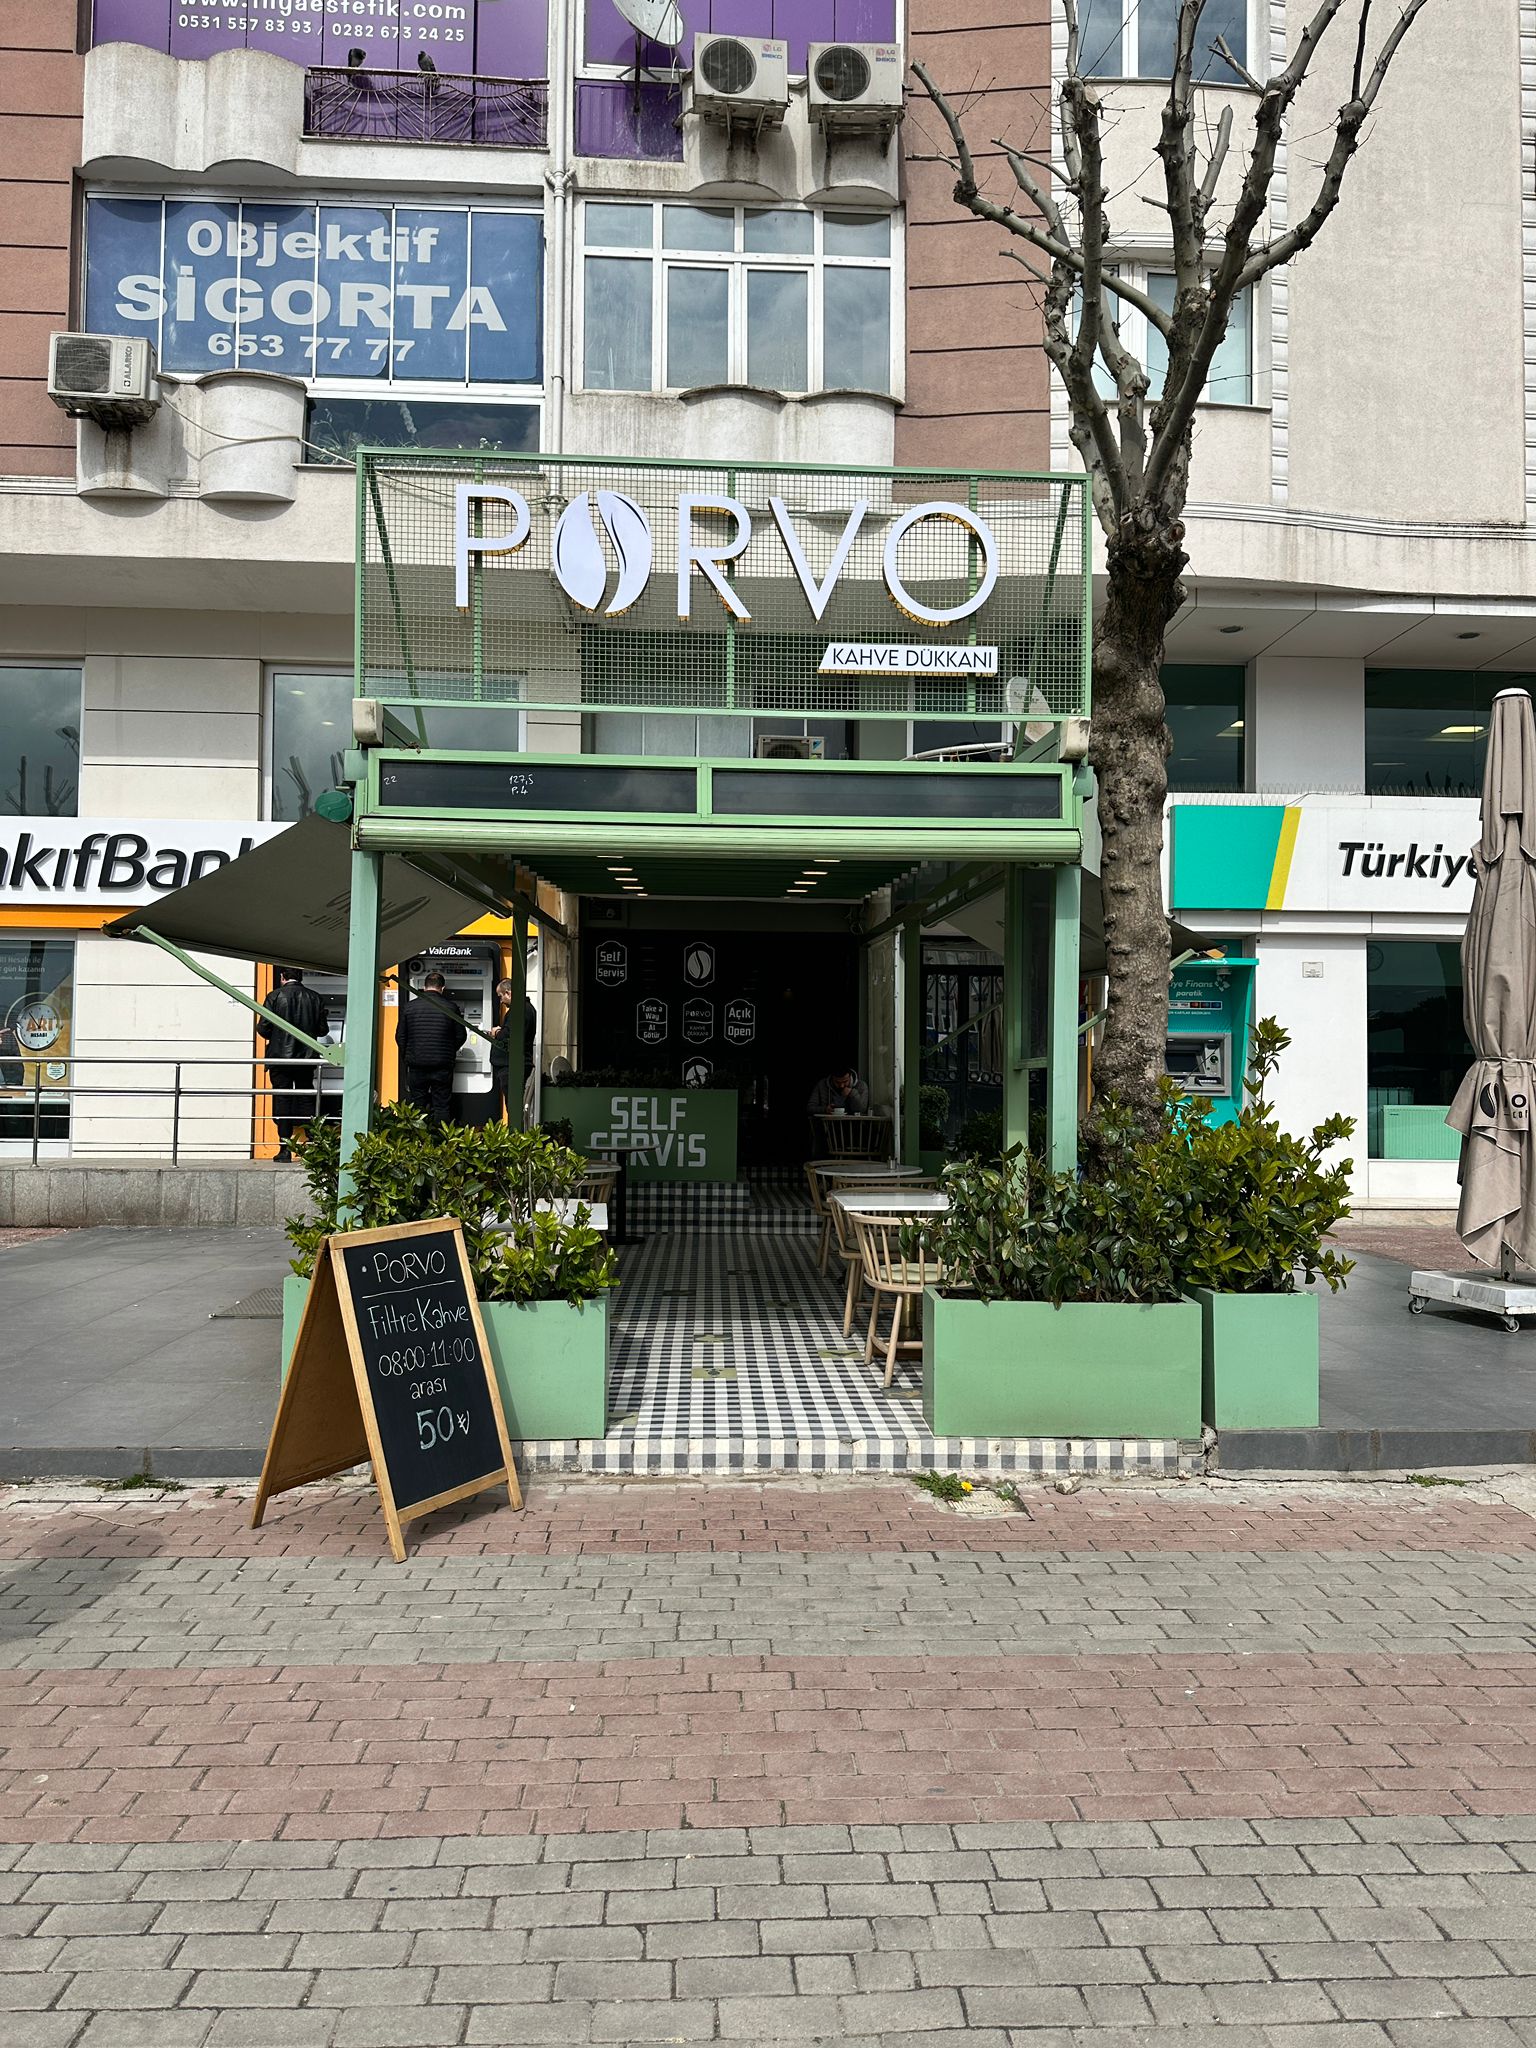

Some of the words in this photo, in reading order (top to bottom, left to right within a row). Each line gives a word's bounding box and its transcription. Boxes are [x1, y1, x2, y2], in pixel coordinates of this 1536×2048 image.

[179, 14, 221, 28] 0531
[227, 17, 258, 31] 557
[265, 19, 285, 32] 83
[291, 20, 312, 33] 93
[332, 23, 374, 37] 0282
[380, 26, 412, 39] 673
[418, 27, 439, 40] 24
[445, 28, 465, 41] 25
[115, 265, 507, 332] SİGORTA
[208, 333, 285, 357] 653
[299, 336, 351, 360] 77
[365, 338, 415, 361] 77
[124, 345, 132, 380] ALARKO
[832, 648, 899, 666] KAHVE
[906, 647, 993, 669] DÜKKANI
[600, 951, 621, 962] Self
[598, 968, 625, 977] Servis
[1185, 979, 1213, 988] Finans
[1175, 990, 1203, 998] paratik
[642, 1004, 657, 1012] Take
[645, 1012, 660, 1021] Way
[728, 1007, 751, 1020] Açık
[728, 1025, 751, 1038] Open
[611, 1096, 687, 1131] SELF
[373, 1250, 446, 1284] PORVO
[367, 1304, 418, 1340] Filtre
[416, 1297, 469, 1331] Kahve
[409, 1377, 448, 1400] arası
